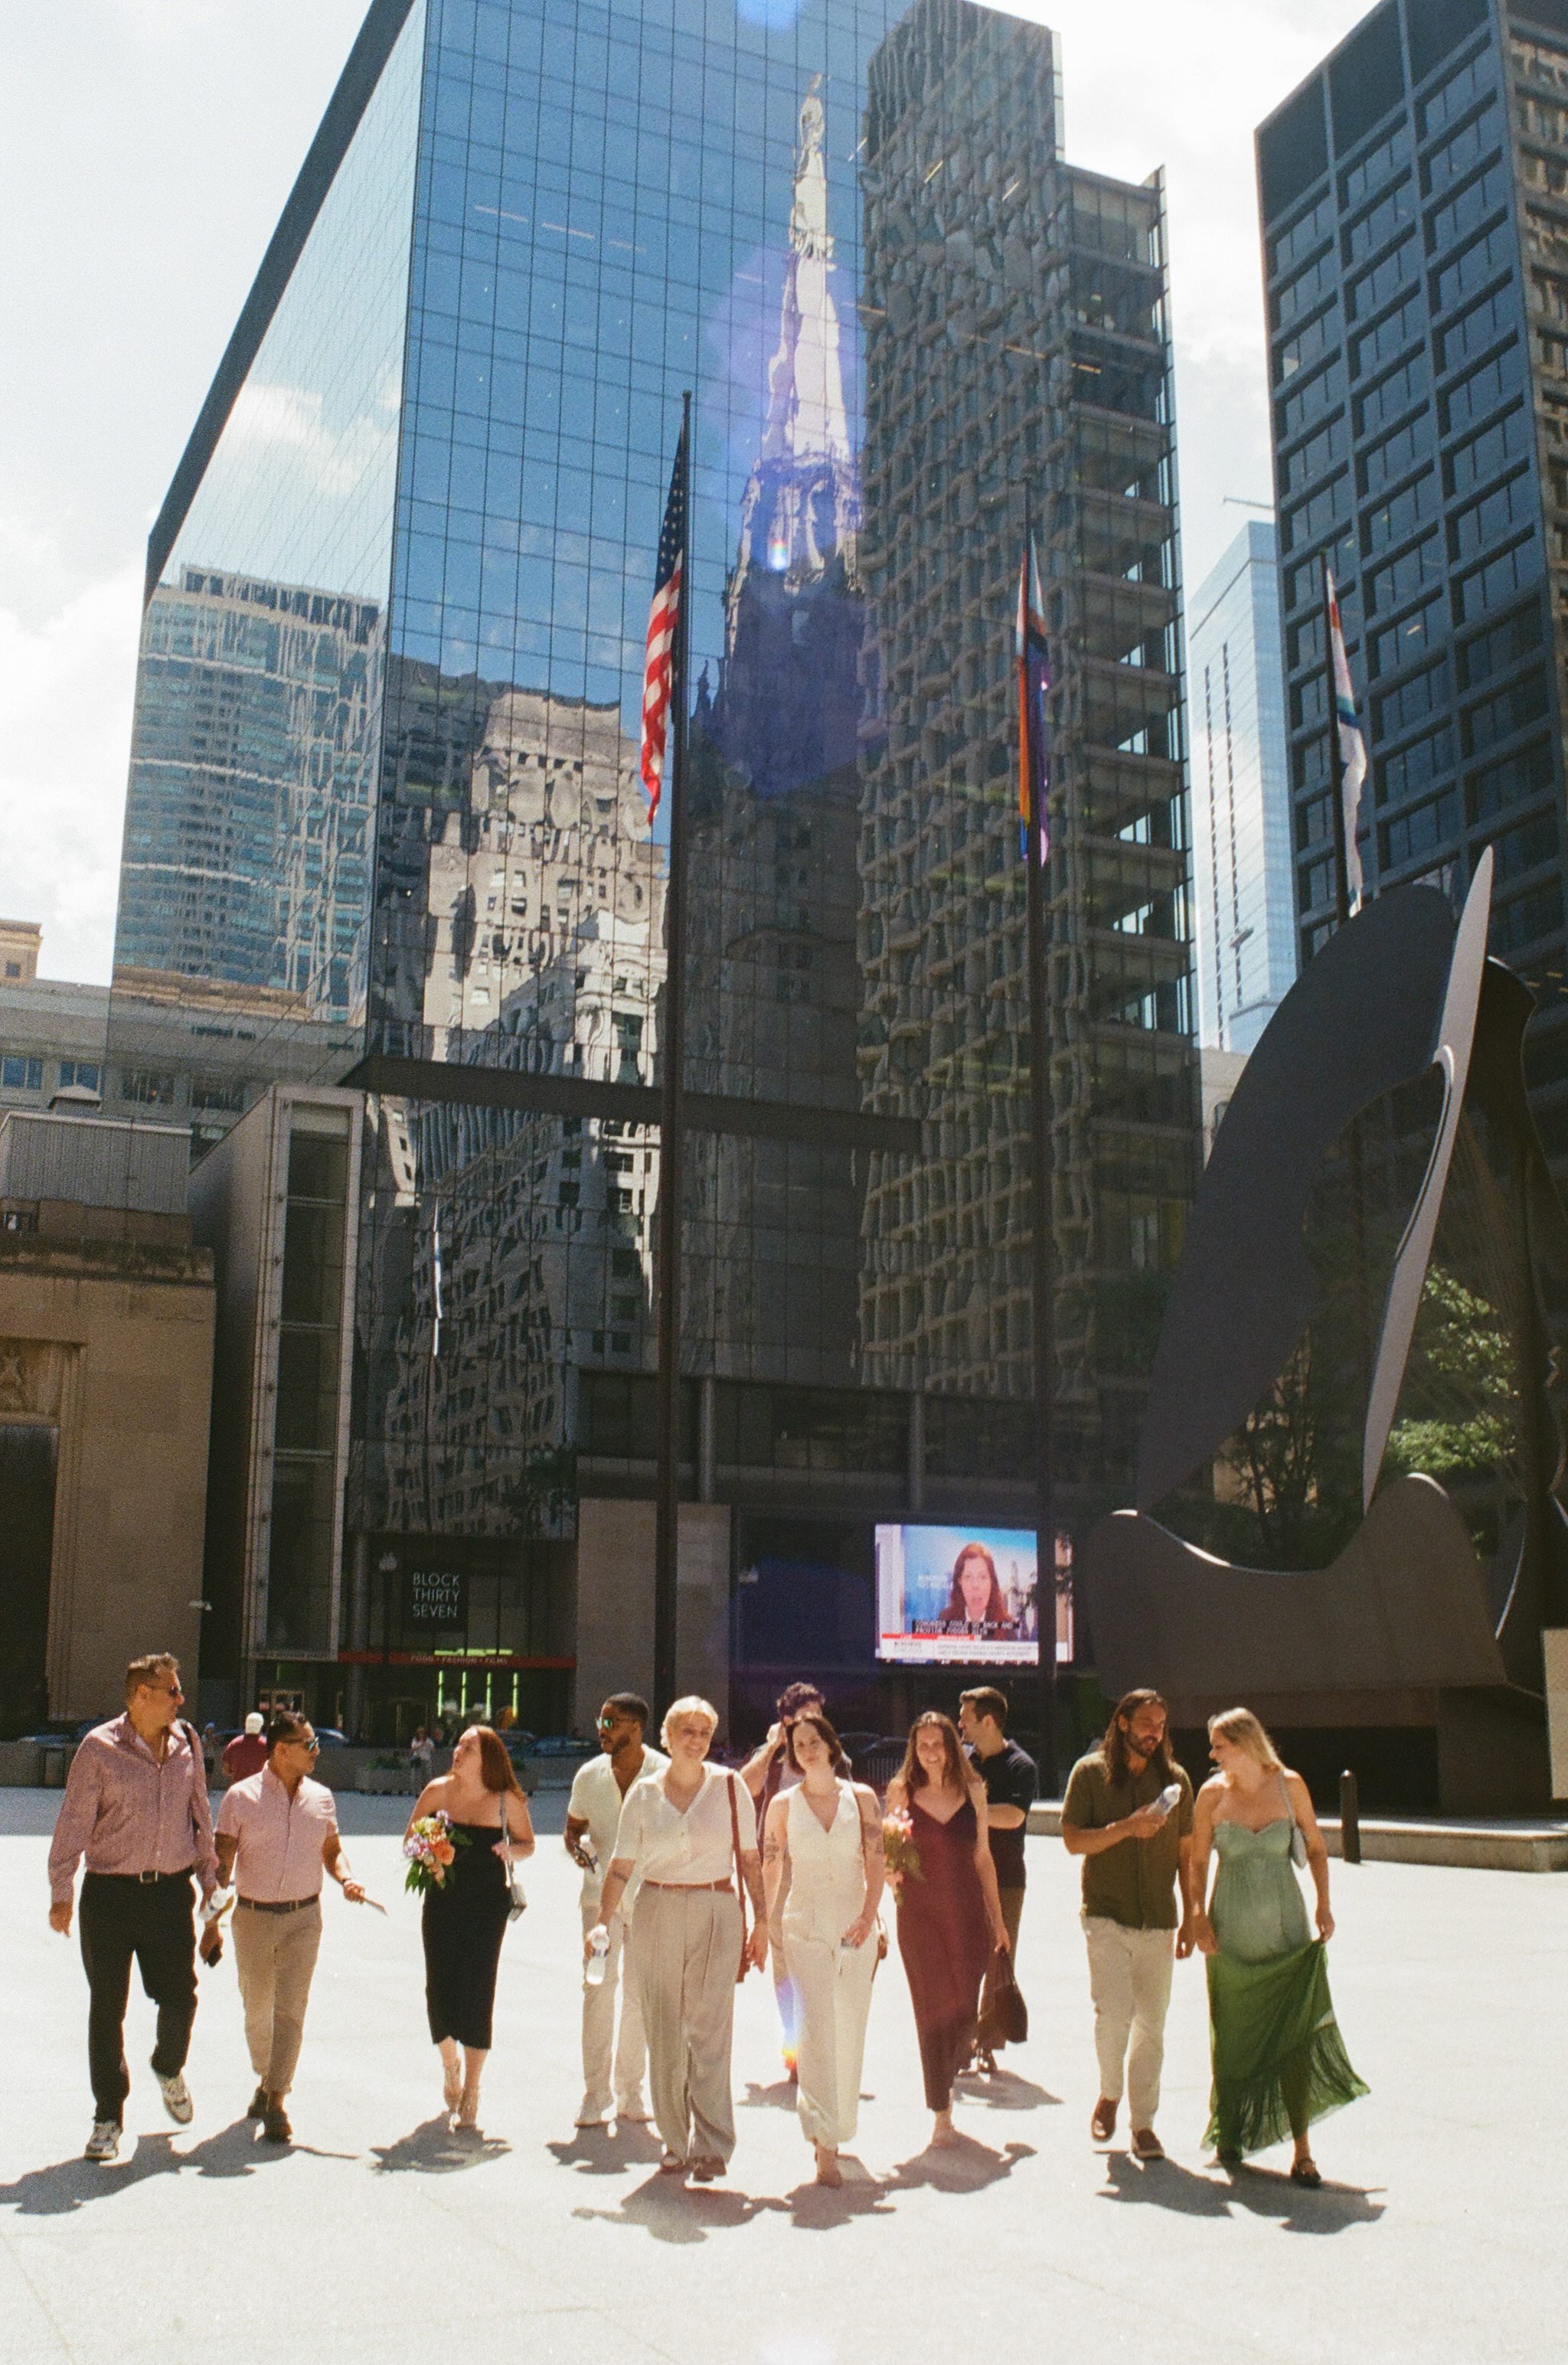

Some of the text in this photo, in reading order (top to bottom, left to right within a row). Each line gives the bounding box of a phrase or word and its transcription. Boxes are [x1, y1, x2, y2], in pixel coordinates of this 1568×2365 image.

[413, 1572, 460, 1587] BLOCK
[413, 1587, 460, 1602] THIRTY
[412, 1603, 458, 1619] SEVEN
